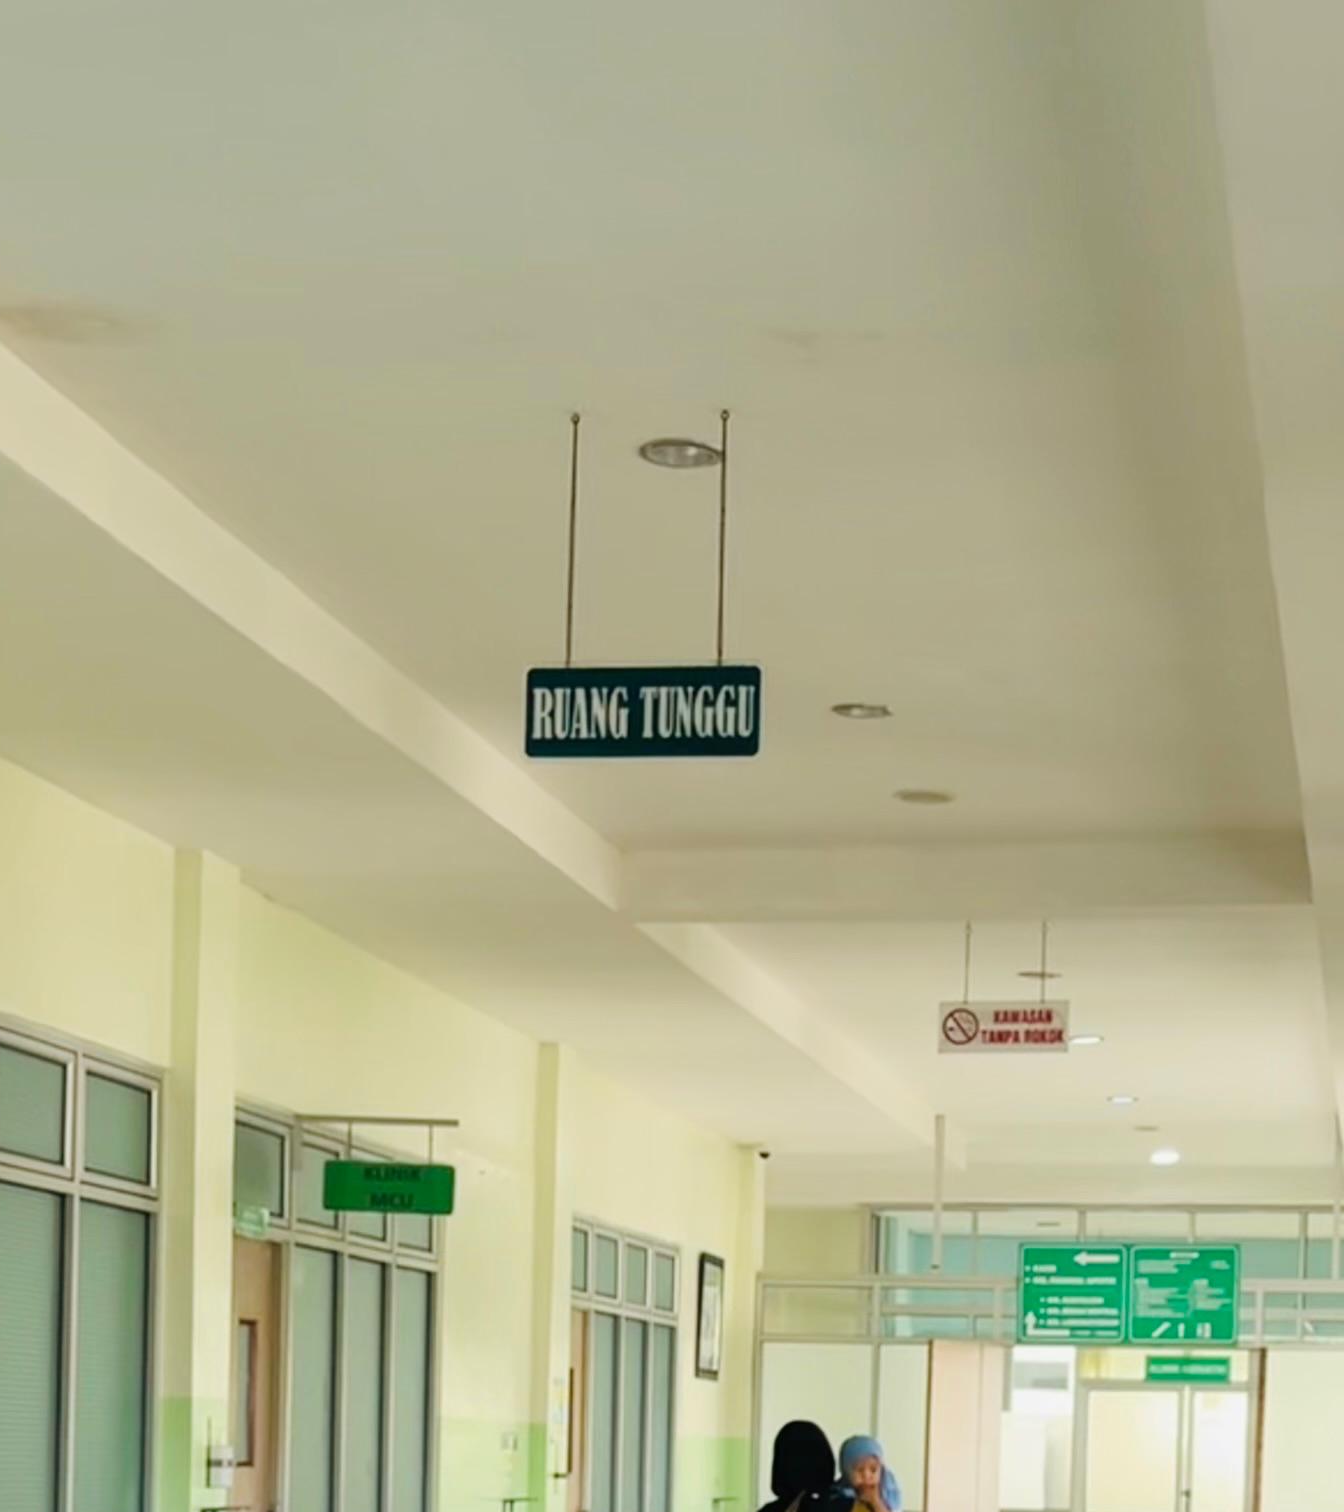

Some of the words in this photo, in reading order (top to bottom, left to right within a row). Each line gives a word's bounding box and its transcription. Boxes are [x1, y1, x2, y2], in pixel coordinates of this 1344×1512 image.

[532, 685, 629, 740] RUANG
[639, 684, 756, 739] TUNGGU
[993, 1009, 1054, 1024] KAWASAN
[981, 1029, 1021, 1044] TANPA
[1024, 1029, 1065, 1043] ROKOK
[369, 1192, 414, 1208] MCU
